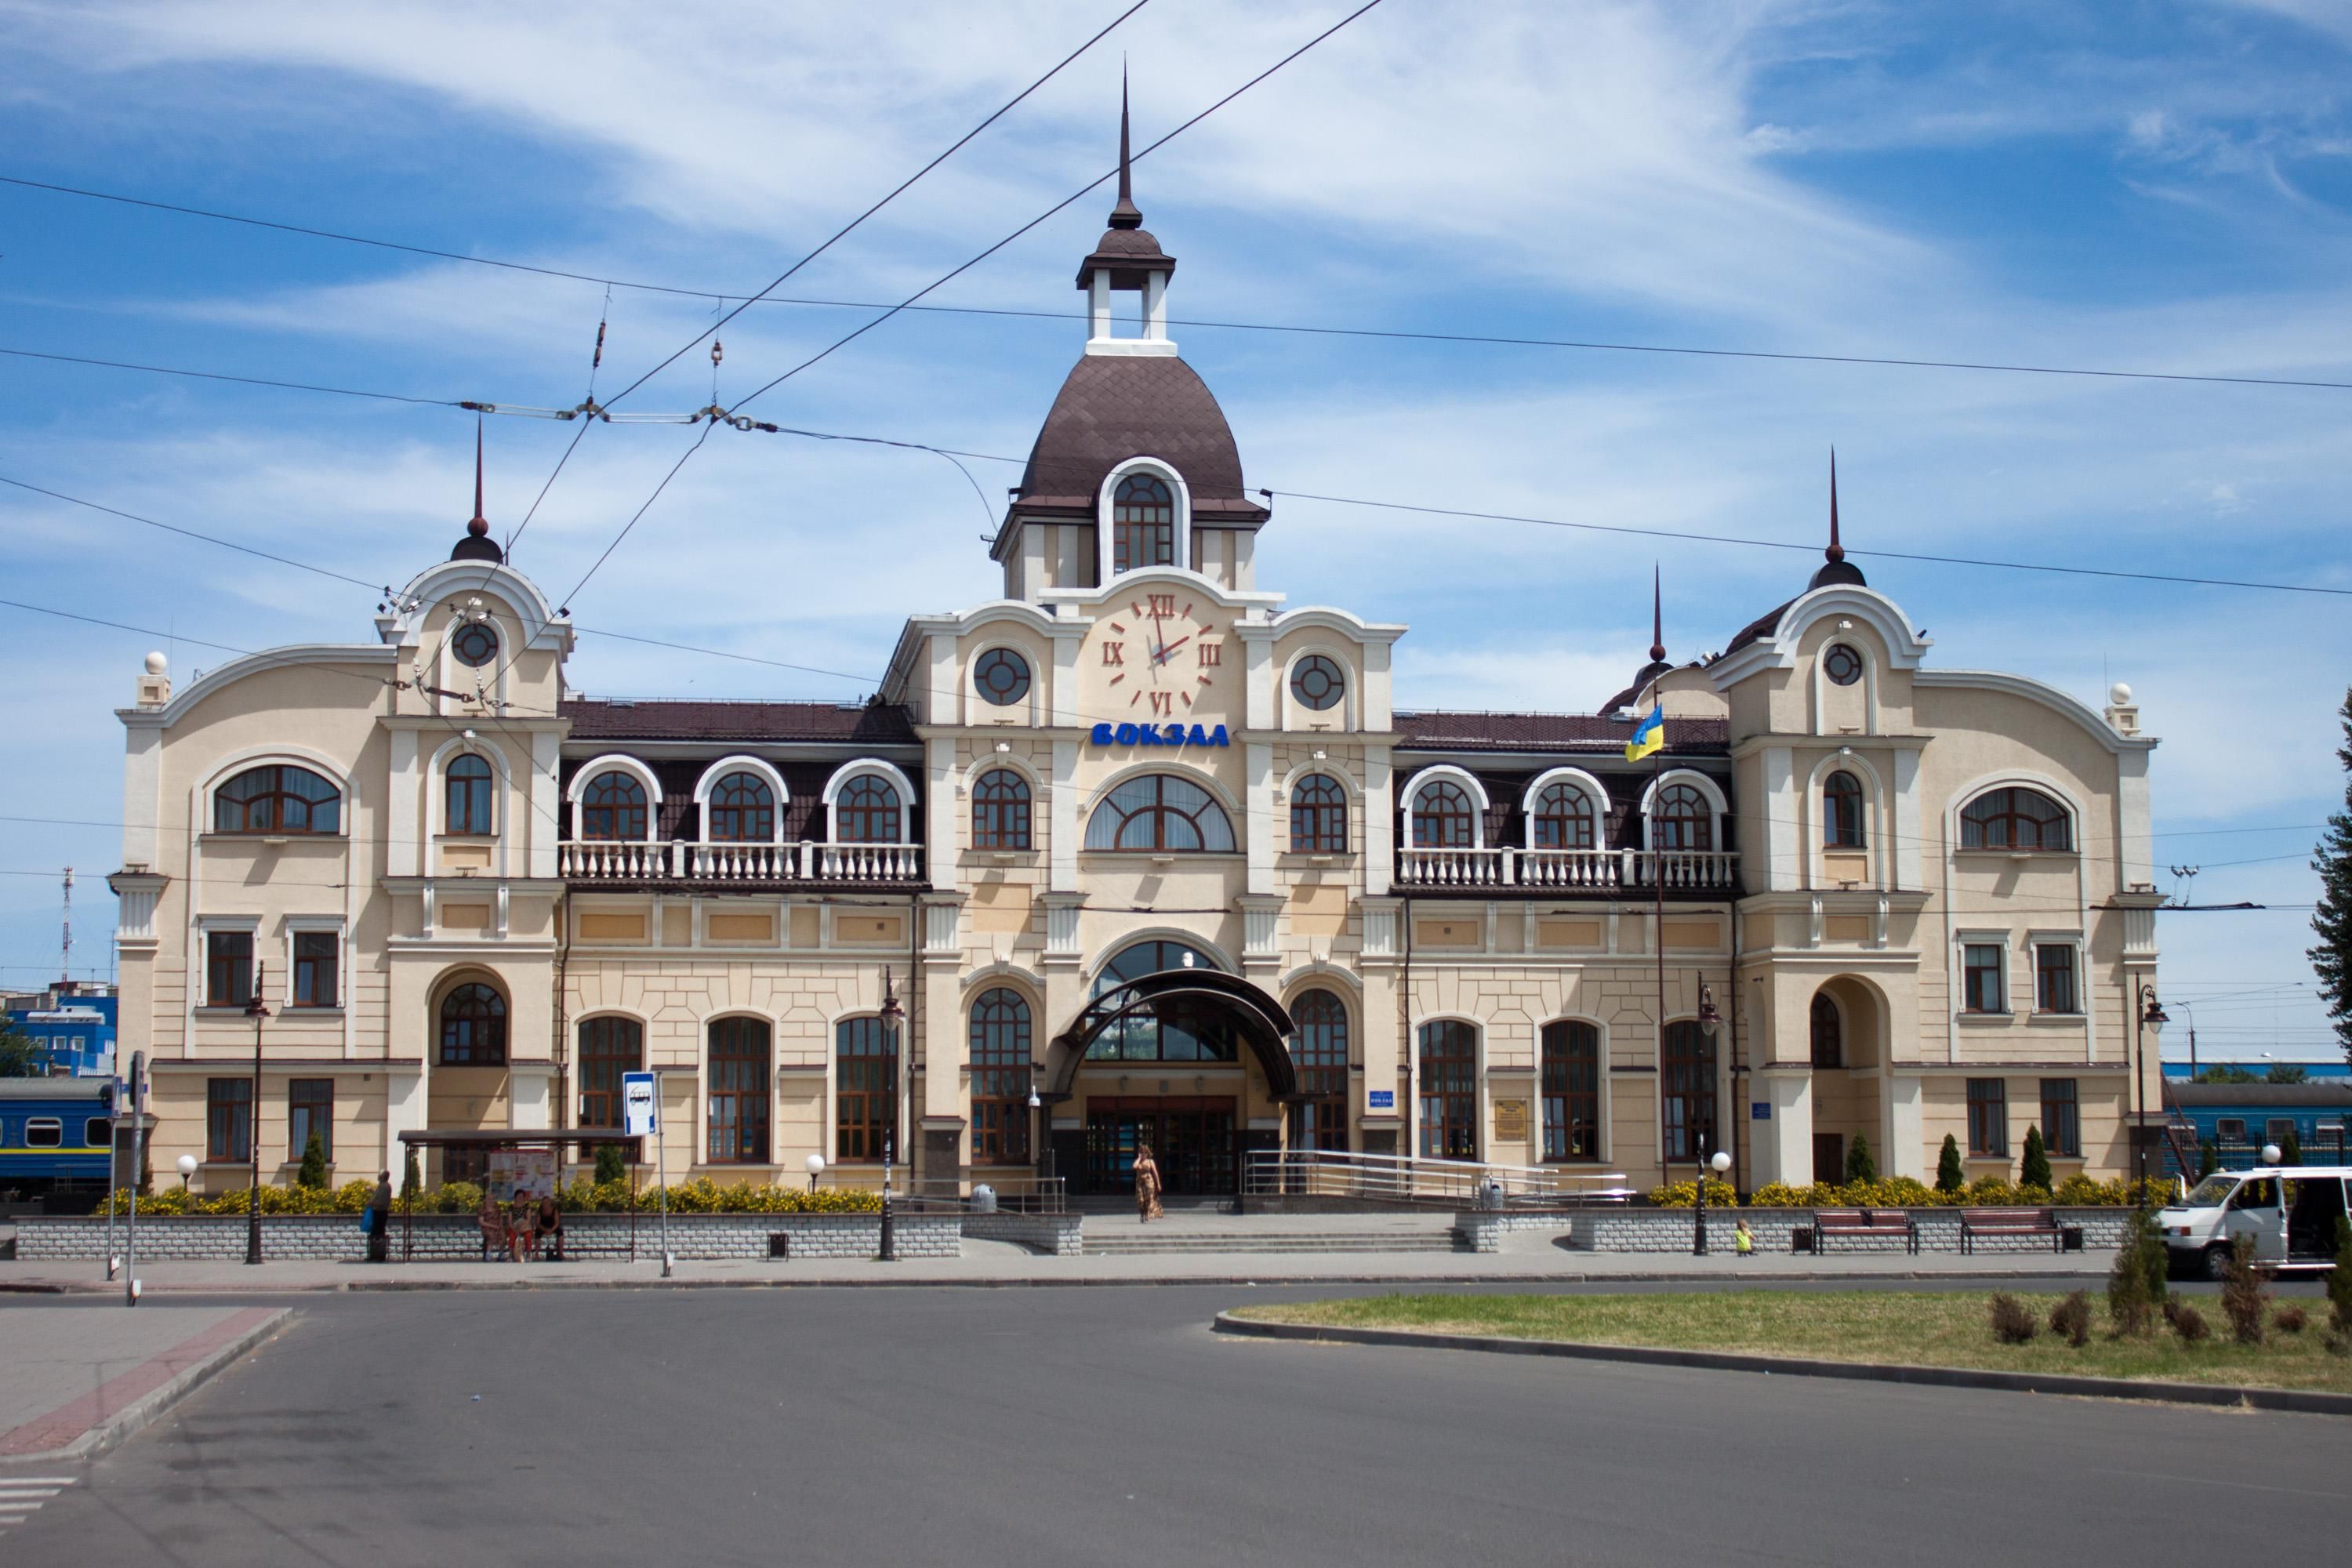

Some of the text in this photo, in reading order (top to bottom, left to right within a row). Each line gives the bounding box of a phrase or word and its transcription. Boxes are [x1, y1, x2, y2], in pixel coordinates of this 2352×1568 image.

[1148, 594, 1174, 617] XII
[1103, 642, 1123, 664] IX
[1200, 644, 1221, 666] III
[1150, 692, 1171, 715] VI
[1092, 723, 1229, 746] ВОКЗАЛ
